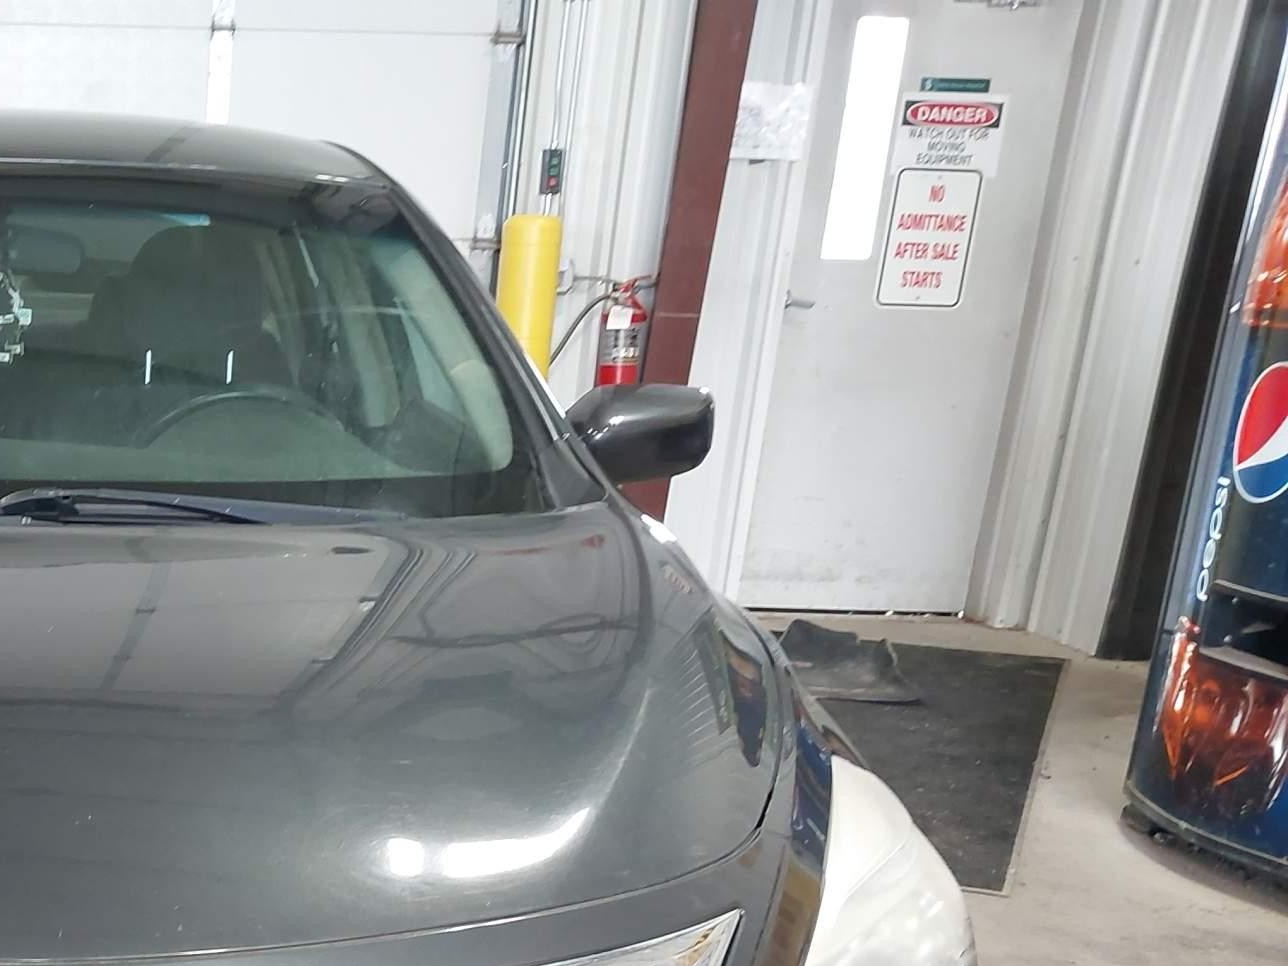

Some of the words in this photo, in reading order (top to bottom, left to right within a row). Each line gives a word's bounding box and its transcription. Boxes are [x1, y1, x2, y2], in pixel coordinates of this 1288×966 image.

[916, 105, 988, 123] DANGER
[909, 128, 942, 138] WATCH
[945, 129, 966, 140] OUT
[968, 130, 990, 141] FOR
[927, 141, 966, 153] MOVING
[916, 153, 974, 167] EQUIPMENT
[928, 184, 946, 203] NO
[896, 213, 968, 232] ADMITTANCE
[894, 242, 929, 260] AFTER
[931, 243, 961, 261] SALE
[900, 270, 943, 289] STARTS
[1196, 477, 1231, 601] pepsi
